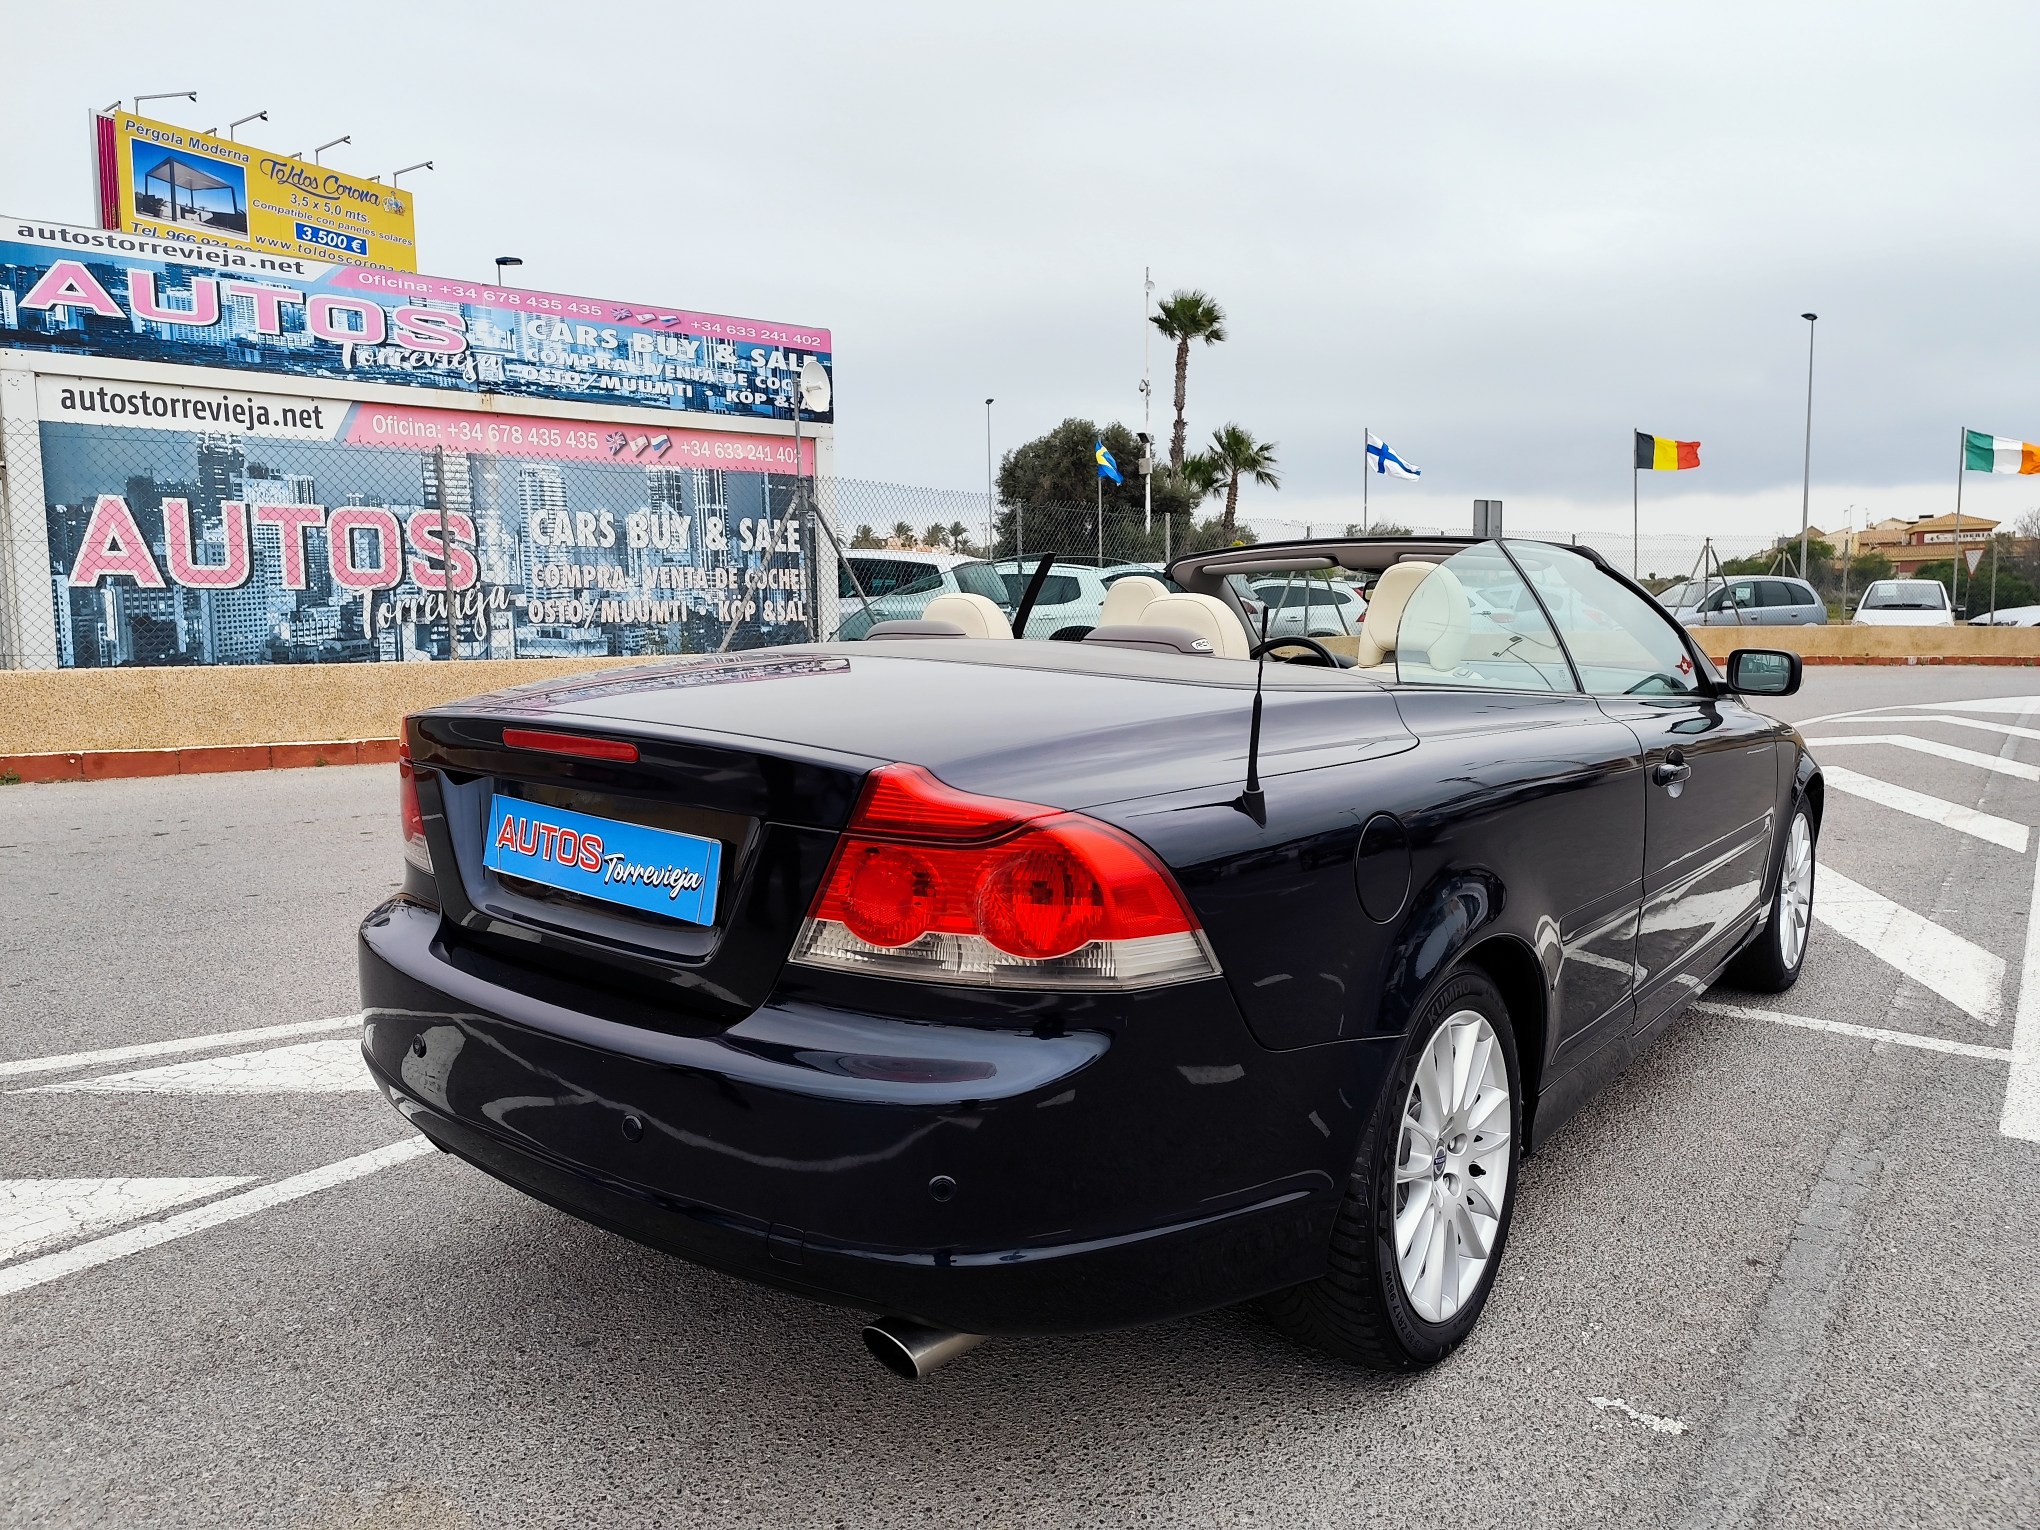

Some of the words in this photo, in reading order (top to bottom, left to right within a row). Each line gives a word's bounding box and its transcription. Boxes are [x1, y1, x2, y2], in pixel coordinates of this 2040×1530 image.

[125, 119, 183, 145] Pérgola
[188, 137, 250, 163] Moderna
[259, 158, 319, 190] Toldos
[323, 175, 381, 207] Corona
[130, 221, 160, 239] Tel.
[252, 199, 313, 222] Compatible
[316, 215, 335, 226] con
[337, 222, 376, 237] paneles
[378, 231, 413, 247] solares
[290, 193, 310, 208] 3,5
[312, 200, 320, 210] x
[323, 202, 342, 216] 5,0
[345, 209, 371, 224] mts.
[17, 225, 305, 275] autostorrevieja.net
[302, 226, 348, 249] 3.500
[351, 238, 363, 253] €
[17, 258, 468, 354] AUTOS
[357, 272, 434, 293] Oficina:
[439, 285, 477, 299] +34
[483, 290, 521, 305] 678
[526, 296, 562, 310] 435
[567, 302, 602, 316] 435
[690, 321, 722, 333] +34
[726, 325, 756, 337] 633
[760, 330, 790, 342] 241
[793, 334, 821, 347] 402
[334, 340, 504, 384] Torrevieja
[526, 319, 619, 350] CARS
[632, 332, 701, 360] BUY
[715, 344, 738, 365] &
[526, 350, 628, 372] COMPRA
[650, 362, 714, 384] VENTA
[723, 371, 748, 386] DE
[60, 386, 325, 431] autostorrevieja.net
[726, 388, 767, 405] KÖP
[371, 414, 442, 438] Oficina:
[447, 421, 483, 441] +34
[488, 424, 523, 444] 678
[528, 427, 562, 447] 435
[565, 430, 599, 450] 435
[681, 440, 710, 458] +34
[715, 442, 744, 459] 633
[747, 444, 773, 462] 241
[68, 494, 479, 592] AUTOS
[529, 508, 616, 549] CARS
[628, 513, 692, 550] BUY
[705, 516, 729, 551] &
[739, 517, 800, 553] SALE
[532, 563, 627, 590] COMPRA
[646, 565, 710, 589] VENTA
[714, 566, 738, 589] DE
[341, 582, 512, 641] Torrevieja
[495, 813, 604, 874] AUTOS
[603, 853, 705, 901] Torrevieja
